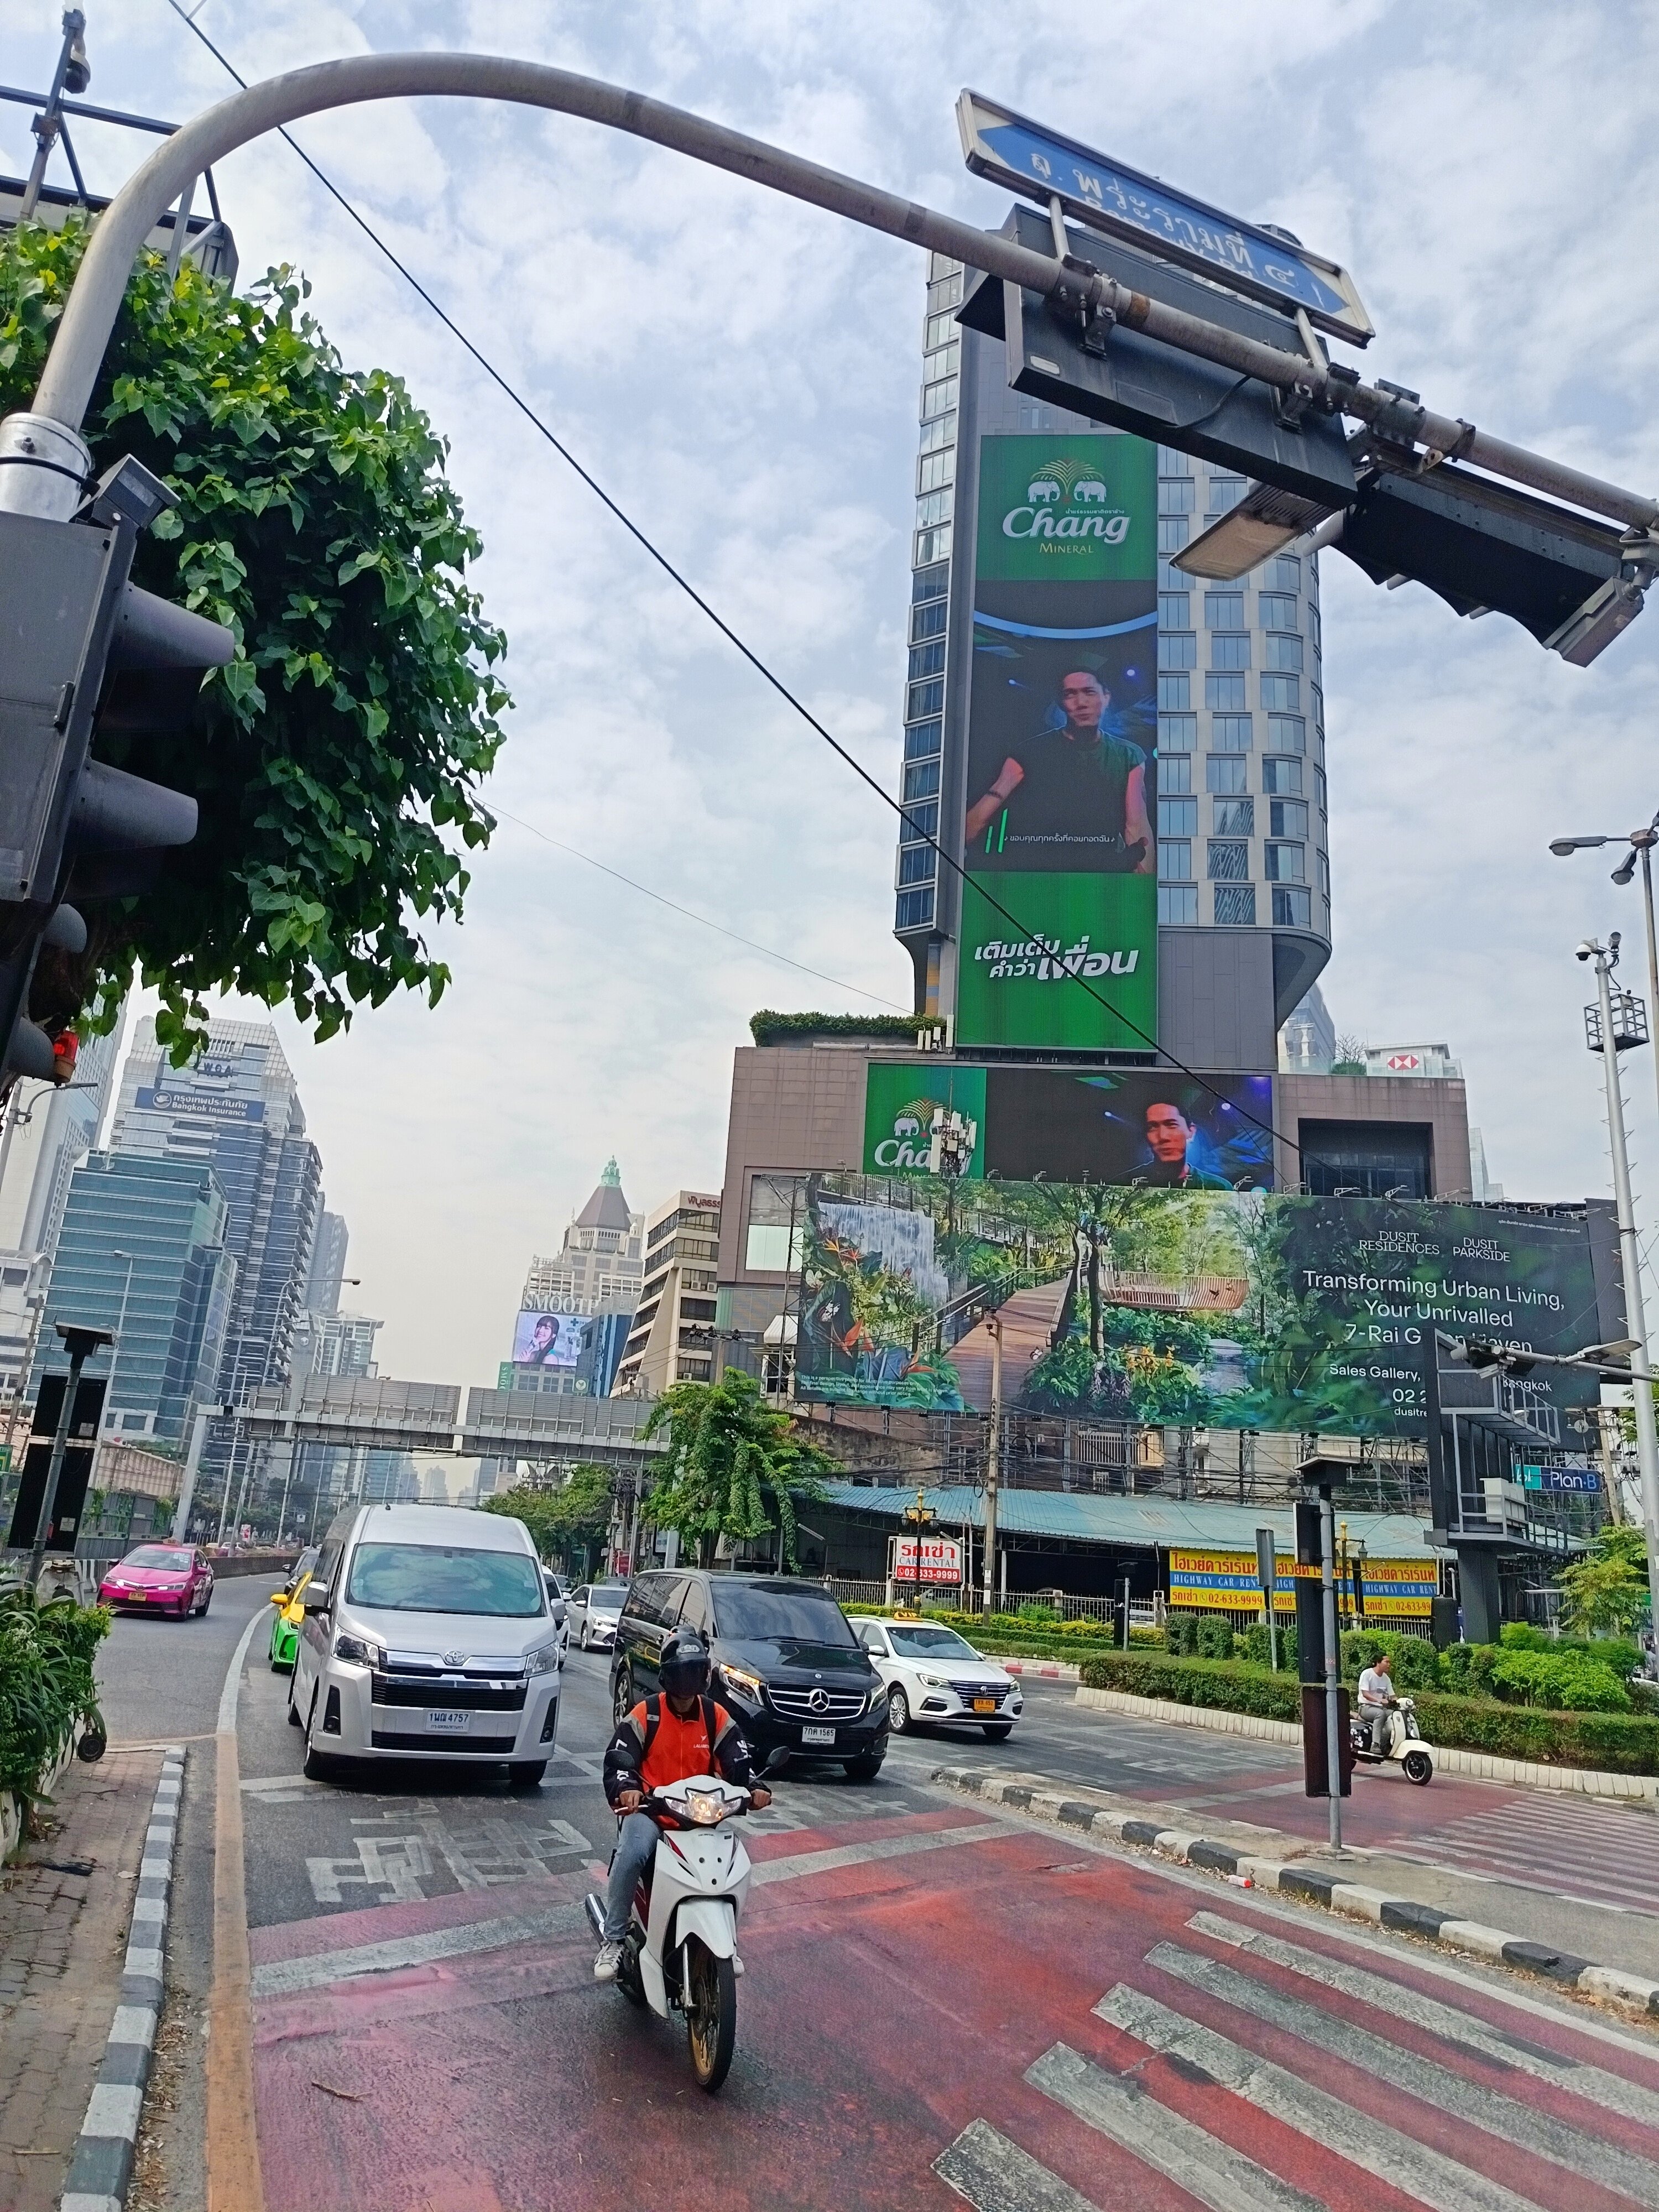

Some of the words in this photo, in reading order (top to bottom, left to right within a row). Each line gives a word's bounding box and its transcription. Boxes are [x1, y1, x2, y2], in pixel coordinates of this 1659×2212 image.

[1003, 507, 1131, 545] Chang
[974, 933, 1060, 960] เติมเต็ม
[989, 959, 1036, 978] คำว่า
[1037, 936, 1139, 980] เพื่อน
[172, 1101, 207, 1112] Bangkok
[208, 1107, 247, 1117] Insurance
[173, 1094, 248, 1109] กรุงเทพประกันภัย
[1379, 1230, 1419, 1243] DUSIT
[1463, 1237, 1499, 1250] DUSIT
[1359, 1240, 1439, 1255] RESIDENCES
[1453, 1247, 1511, 1262] PARKSIDE
[1303, 1270, 1437, 1298] Transforming
[1443, 1279, 1500, 1301] Urban
[1506, 1286, 1565, 1311] Living,
[1364, 1300, 1412, 1318] Your
[1416, 1302, 1513, 1327] Unrivalled
[1345, 1323, 1399, 1344] 7-Rai
[1329, 1364, 1366, 1377] Sales
[1370, 1366, 1421, 1382] Gallery,
[1392, 1389, 1415, 1404] 02
[901, 1542, 955, 1559] รถเช่า
[899, 1556, 917, 1565] CAR
[921, 1557, 957, 1568] RENTAL
[1172, 1552, 1257, 1574] ไฮเวย์คาร์เร้นท
[904, 1568, 958, 1580] 02-633-9999
[1174, 1574, 1213, 1585] HIGHWAY
[1218, 1577, 1234, 1587] CAR
[1365, 1584, 1398, 1593] HIGHWAY
[1402, 1584, 1416, 1594] CAR
[1420, 1585, 1437, 1594] RENT
[1172, 1589, 1198, 1602] รถเช่า
[1208, 1593, 1262, 1605] 02-633-9999
[1365, 1598, 1387, 1611] รถเช่า
[1396, 1601, 1431, 1611] 02-633-99
[448, 1713, 469, 1723] 4757
